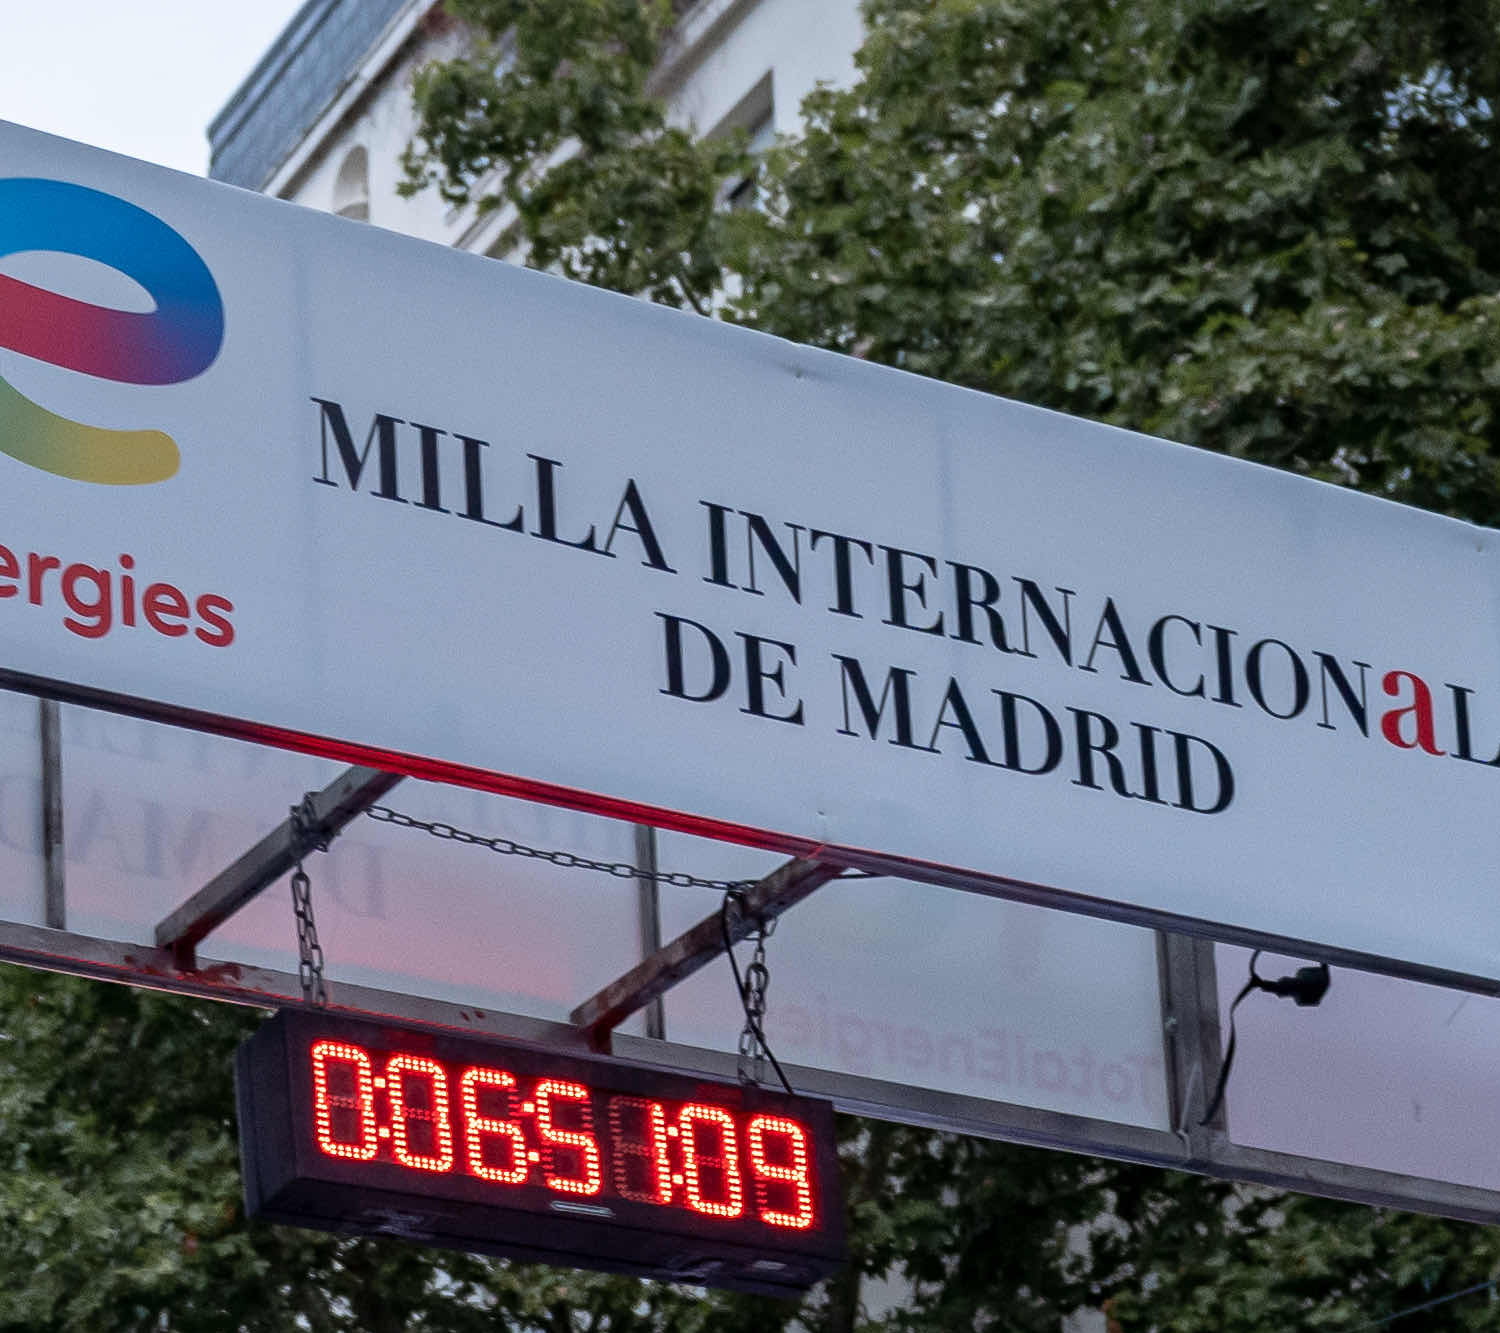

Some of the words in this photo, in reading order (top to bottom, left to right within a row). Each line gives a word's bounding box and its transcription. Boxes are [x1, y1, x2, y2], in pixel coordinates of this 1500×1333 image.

[310, 396, 677, 575] MILLA
[656, 610, 804, 726] DE
[830, 653, 1236, 815] MADRID
